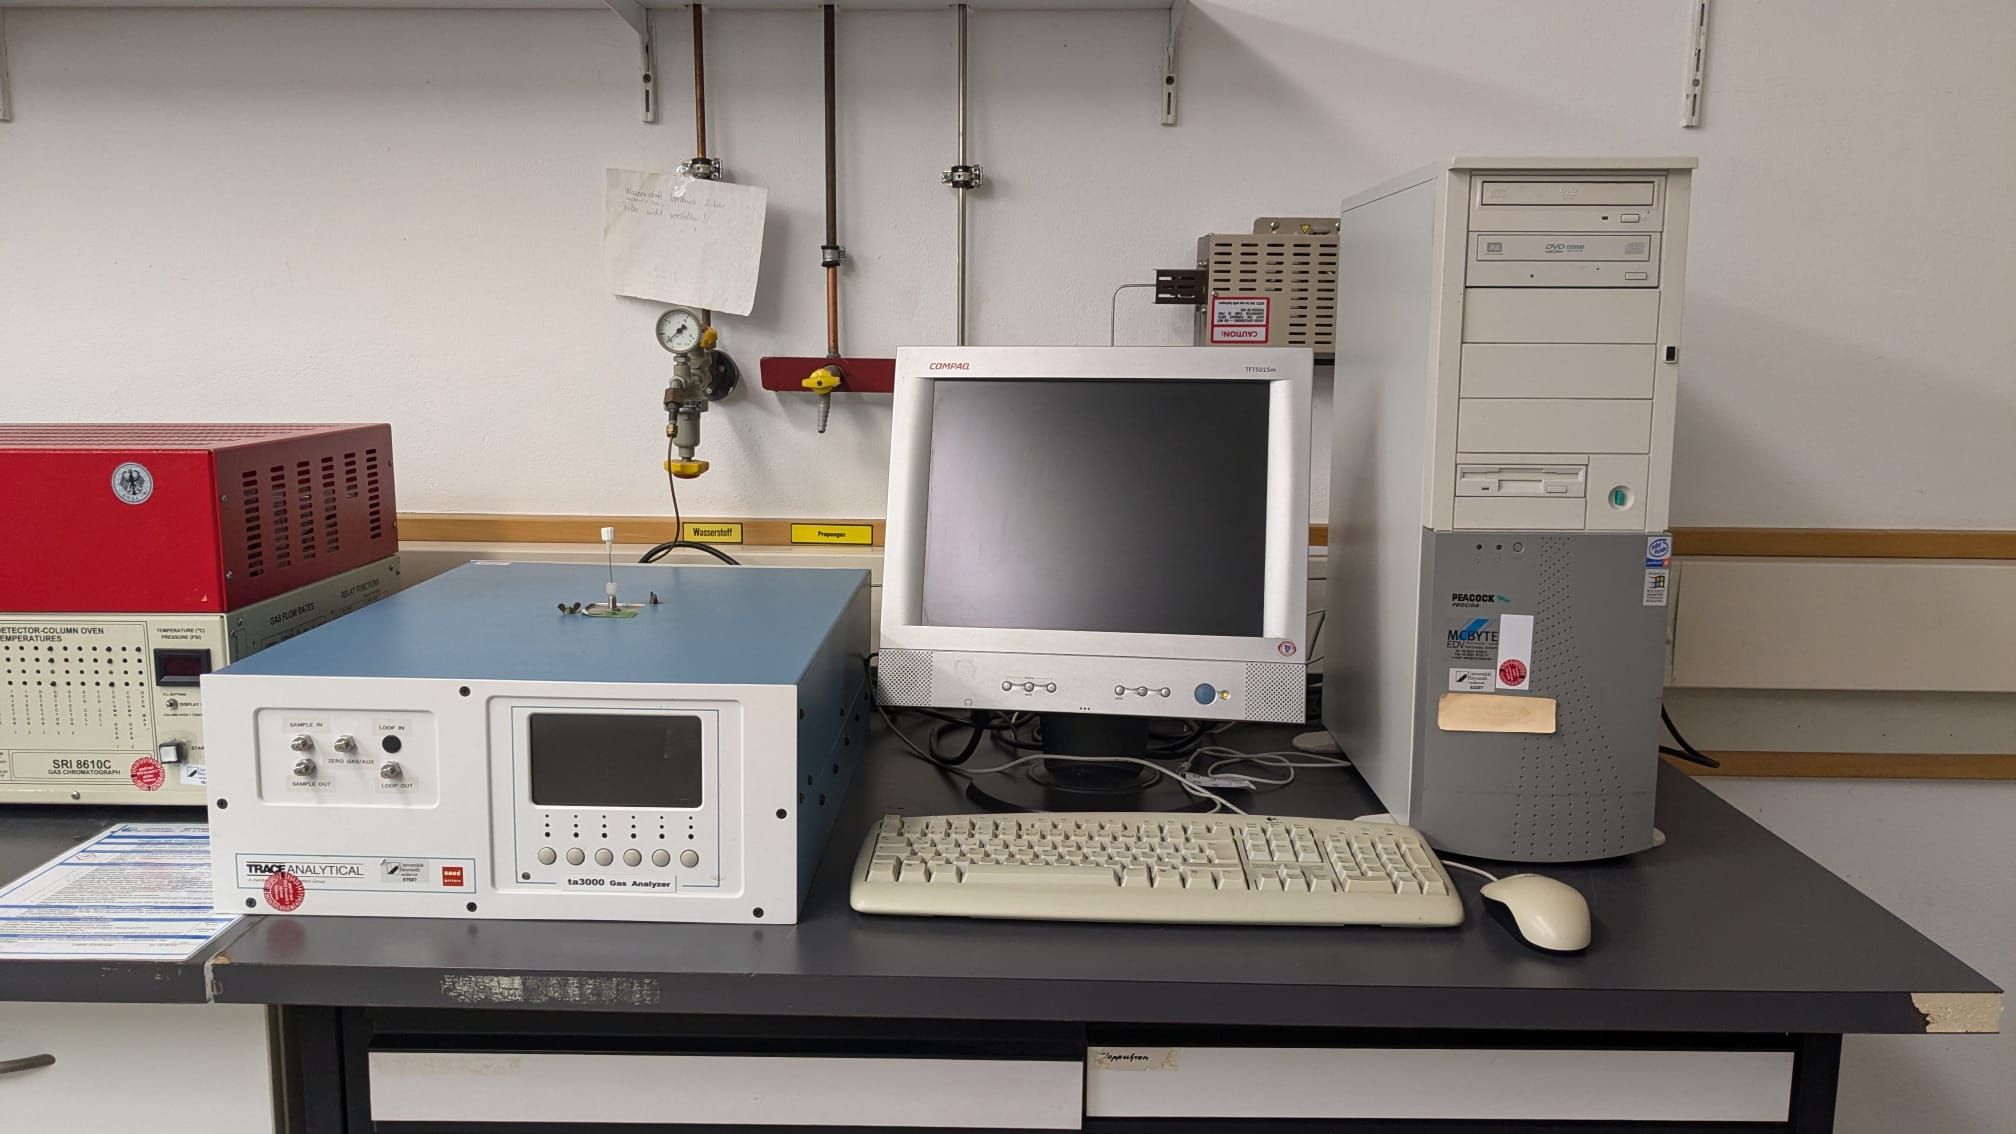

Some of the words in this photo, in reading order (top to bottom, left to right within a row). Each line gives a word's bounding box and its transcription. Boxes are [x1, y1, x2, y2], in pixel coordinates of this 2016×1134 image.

[929, 362, 970, 371] COMPAQ
[692, 527, 733, 537] Wasserstoff
[1451, 593, 1495, 603] PEACOCK
[269, 614, 282, 626] GAS
[282, 608, 299, 622] FLOW
[298, 602, 316, 615] RATES
[0, 626, 78, 635] ETECTOR-COLUMN
[80, 627, 104, 635] OVEN
[0, 634, 62, 642] EMPERATURES
[1447, 630, 1499, 642] MCBYTE
[1446, 640, 1466, 649] EDV
[52, 759, 72, 769] SRI
[75, 759, 112, 770] 8610C
[60, 769, 121, 777] CHROMATOGRAPH
[246, 863, 286, 874] TRACE
[287, 865, 365, 876] ANALYTICAL
[567, 878, 605, 887] ta3000
[609, 879, 627, 887] Gas
[631, 880, 671, 889] Analyzer
